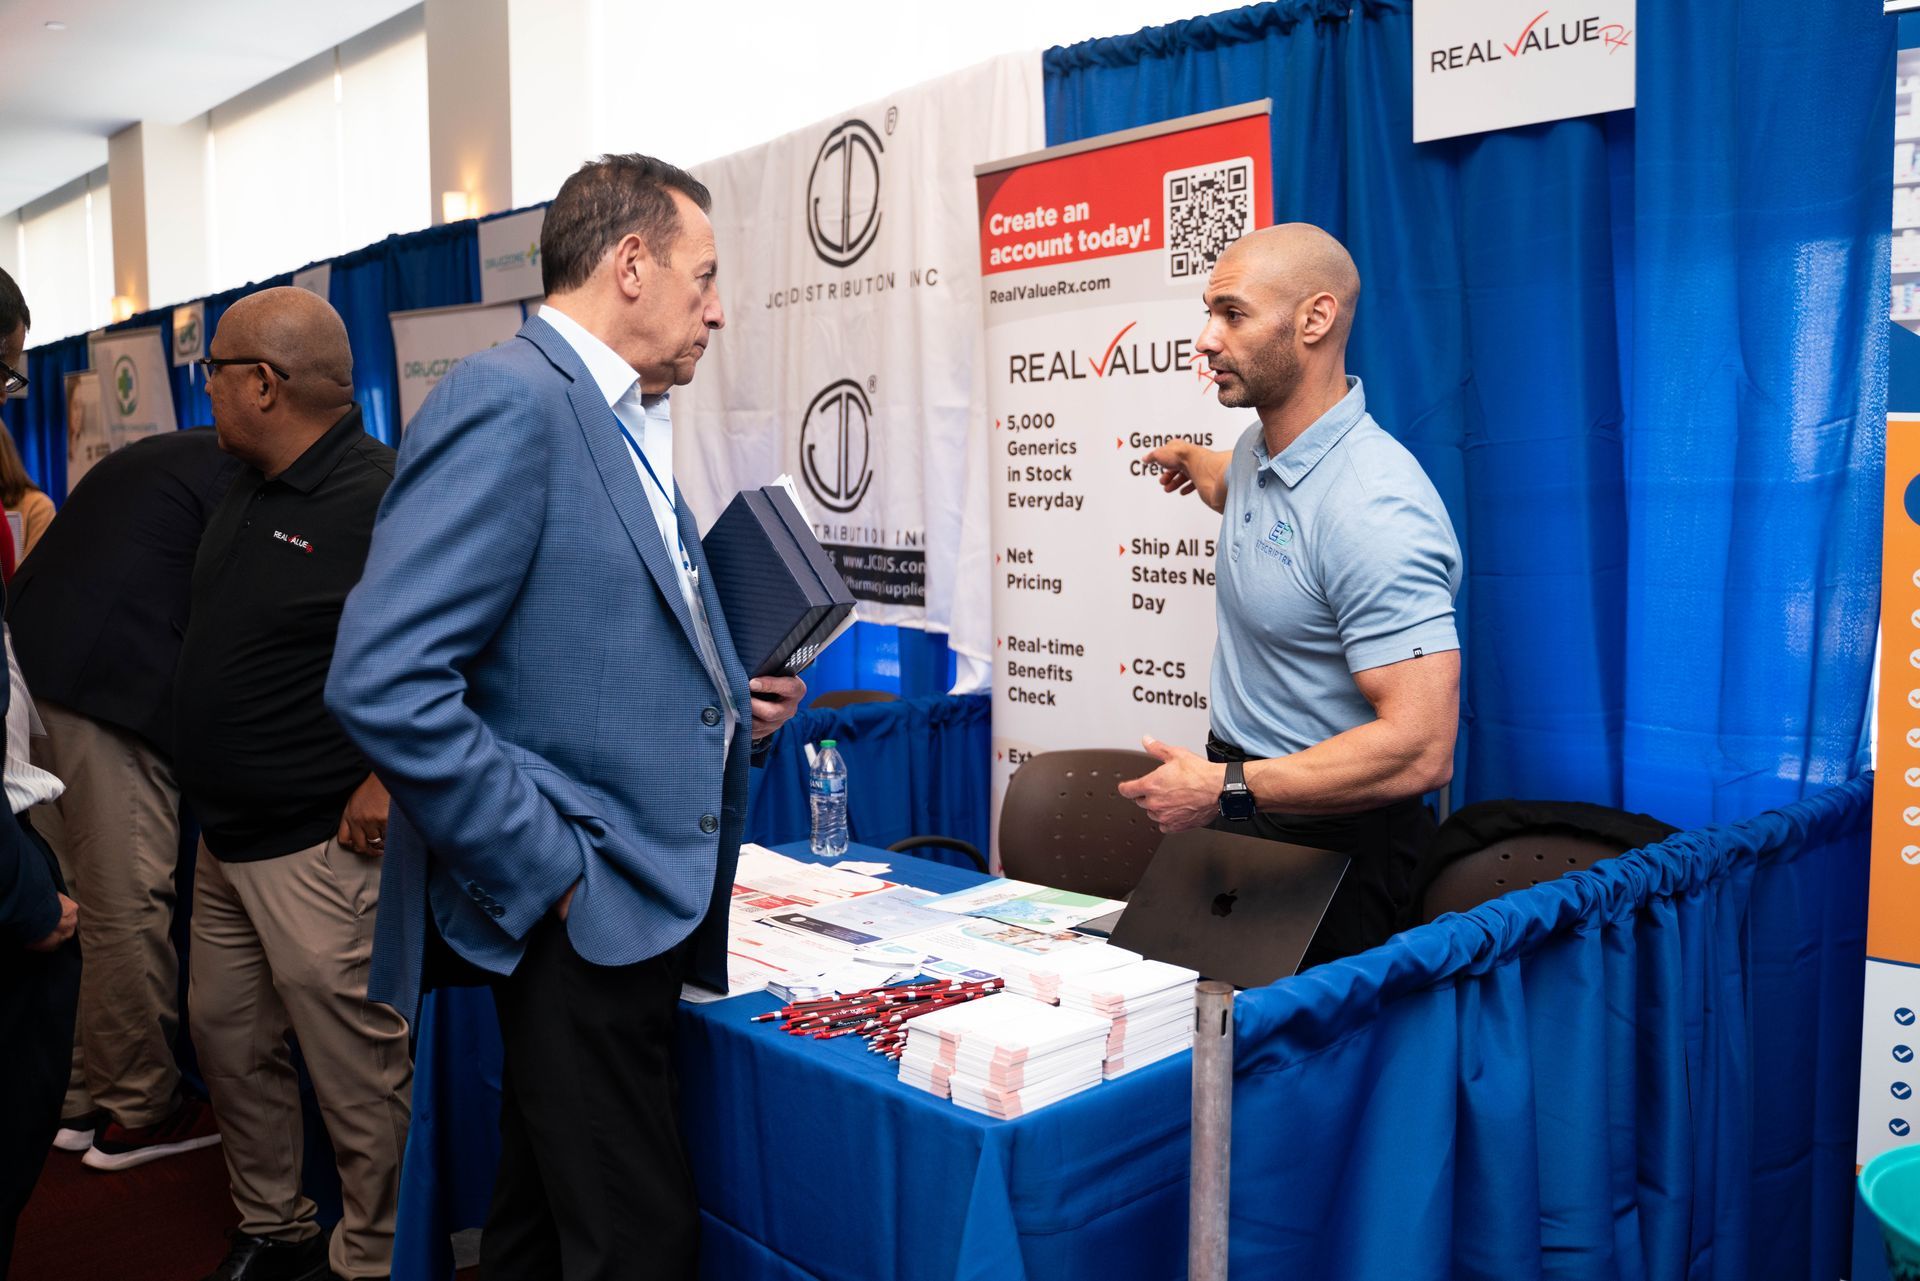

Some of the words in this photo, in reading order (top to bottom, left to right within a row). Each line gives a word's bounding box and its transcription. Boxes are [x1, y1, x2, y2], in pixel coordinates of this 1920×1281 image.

[1430, 39, 1501, 73] REAL
[989, 206, 1058, 236] Create
[1062, 201, 1090, 224] an
[989, 232, 1074, 266] account
[1077, 217, 1151, 252] today!
[909, 268, 938, 288] INC
[989, 277, 1111, 304] RealValueRx.com
[1010, 350, 1087, 384] REAL
[1007, 413, 1055, 432] 5,000
[1007, 438, 1077, 456] Generics
[1007, 466, 1021, 482] in
[1025, 464, 1072, 482] Stock
[1007, 491, 1084, 511] Everyday
[1006, 547, 1034, 564] Net
[1131, 538, 1170, 559] Ship
[1175, 538, 1199, 556] All
[1204, 539, 1217, 558] 5
[1007, 573, 1062, 594] Pricing
[1131, 565, 1187, 584] States
[1192, 568, 1216, 586] Ne
[1132, 593, 1166, 614] Day
[1008, 635, 1085, 657] Real-time
[1008, 661, 1073, 682] Benefits
[1132, 658, 1186, 679] C2-C5
[1008, 686, 1056, 706] Check
[1132, 685, 1208, 710] Controls
